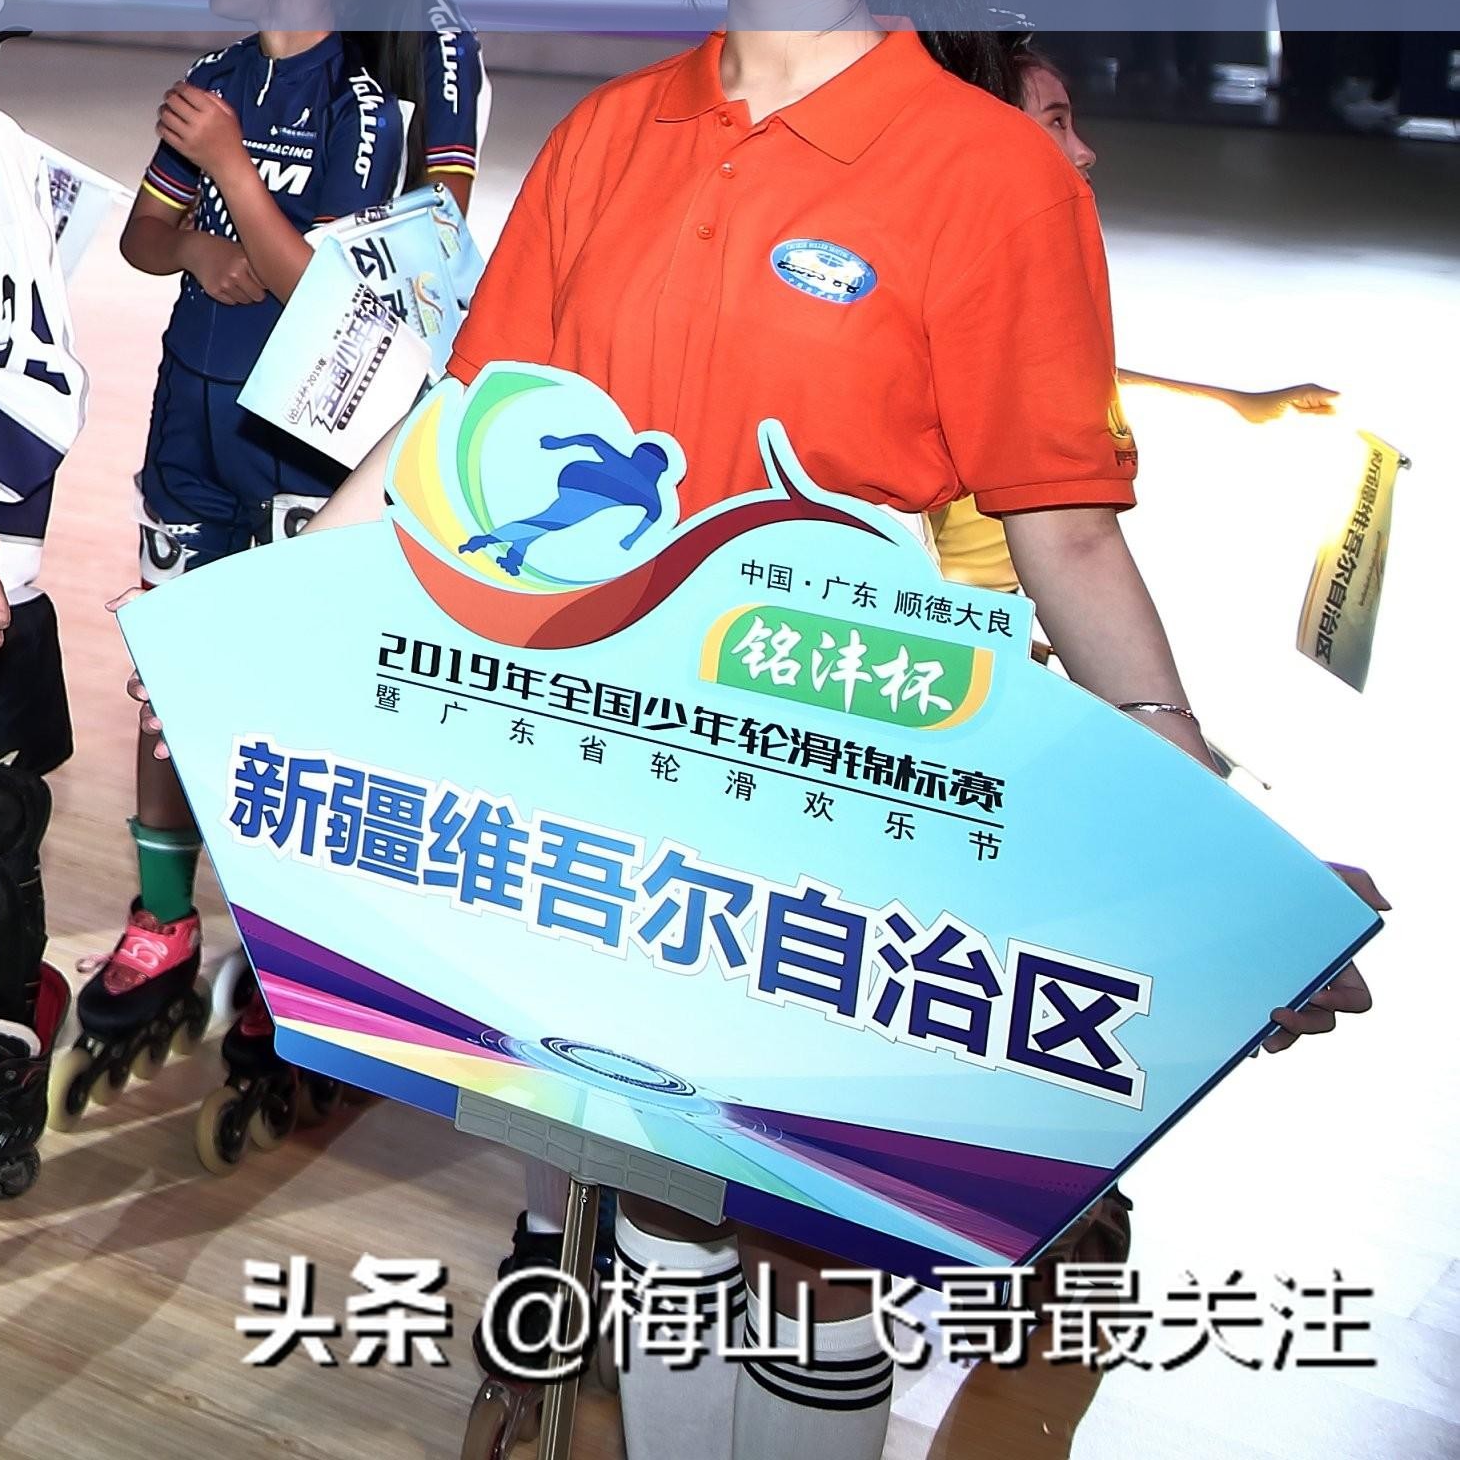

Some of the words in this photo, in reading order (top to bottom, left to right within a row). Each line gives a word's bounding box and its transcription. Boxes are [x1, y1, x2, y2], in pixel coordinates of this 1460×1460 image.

[267, 142, 314, 160] RACING
[731, 614, 954, 718] 铭沣杯
[893, 589, 1015, 638] 顺德大良
[375, 684, 1002, 863] 暨广东省轮滑欢乐节
[378, 632, 1005, 813] 2019年全国少年轮滑锦标赛
[232, 740, 1147, 1097] 新疆维吾尔自治区
